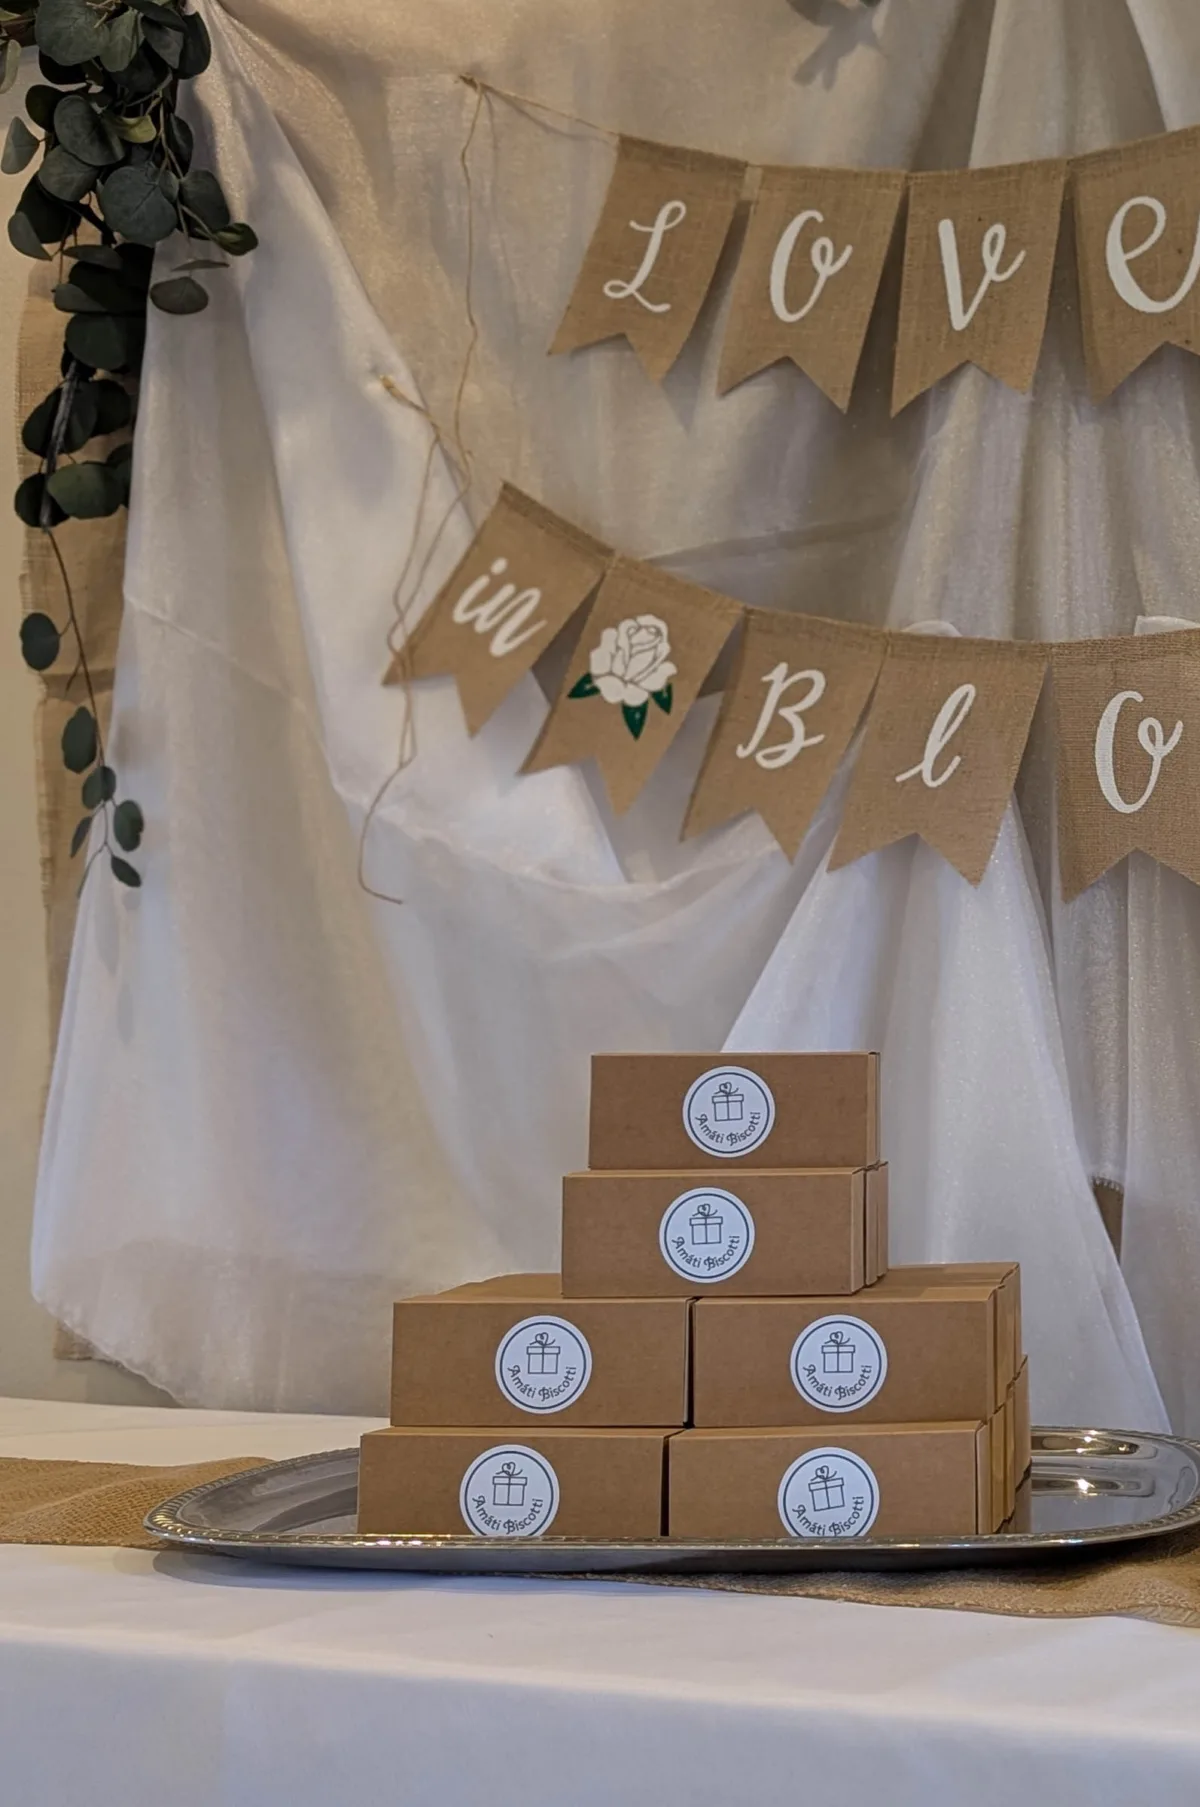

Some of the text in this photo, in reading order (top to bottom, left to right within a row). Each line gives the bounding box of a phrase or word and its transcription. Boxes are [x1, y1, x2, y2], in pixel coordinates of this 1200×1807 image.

[452, 556, 547, 657] in
[726, 1111, 761, 1146] Biscotti
[703, 1235, 740, 1271] Biscotti
[538, 1366, 577, 1401] Biscotti
[834, 1364, 872, 1400] Biscotti
[502, 1498, 544, 1534] Biscotti
[828, 1496, 864, 1537] Biscotti
